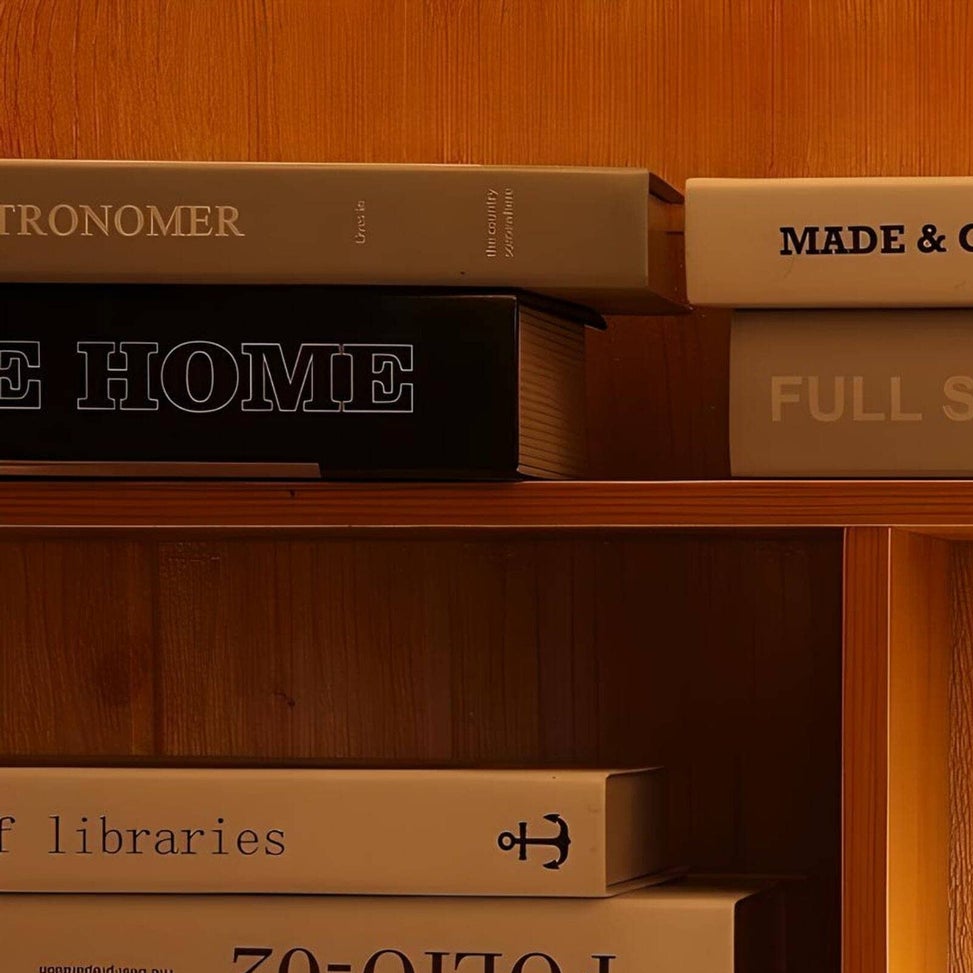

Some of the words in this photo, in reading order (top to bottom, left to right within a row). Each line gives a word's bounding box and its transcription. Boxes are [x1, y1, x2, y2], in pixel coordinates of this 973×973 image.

[0, 205, 246, 237] TRONOMER
[780, 225, 905, 256] MADE
[917, 224, 947, 254] &
[77, 341, 414, 413] HOME
[770, 376, 924, 423] FULL
[48, 815, 286, 856] libraries
